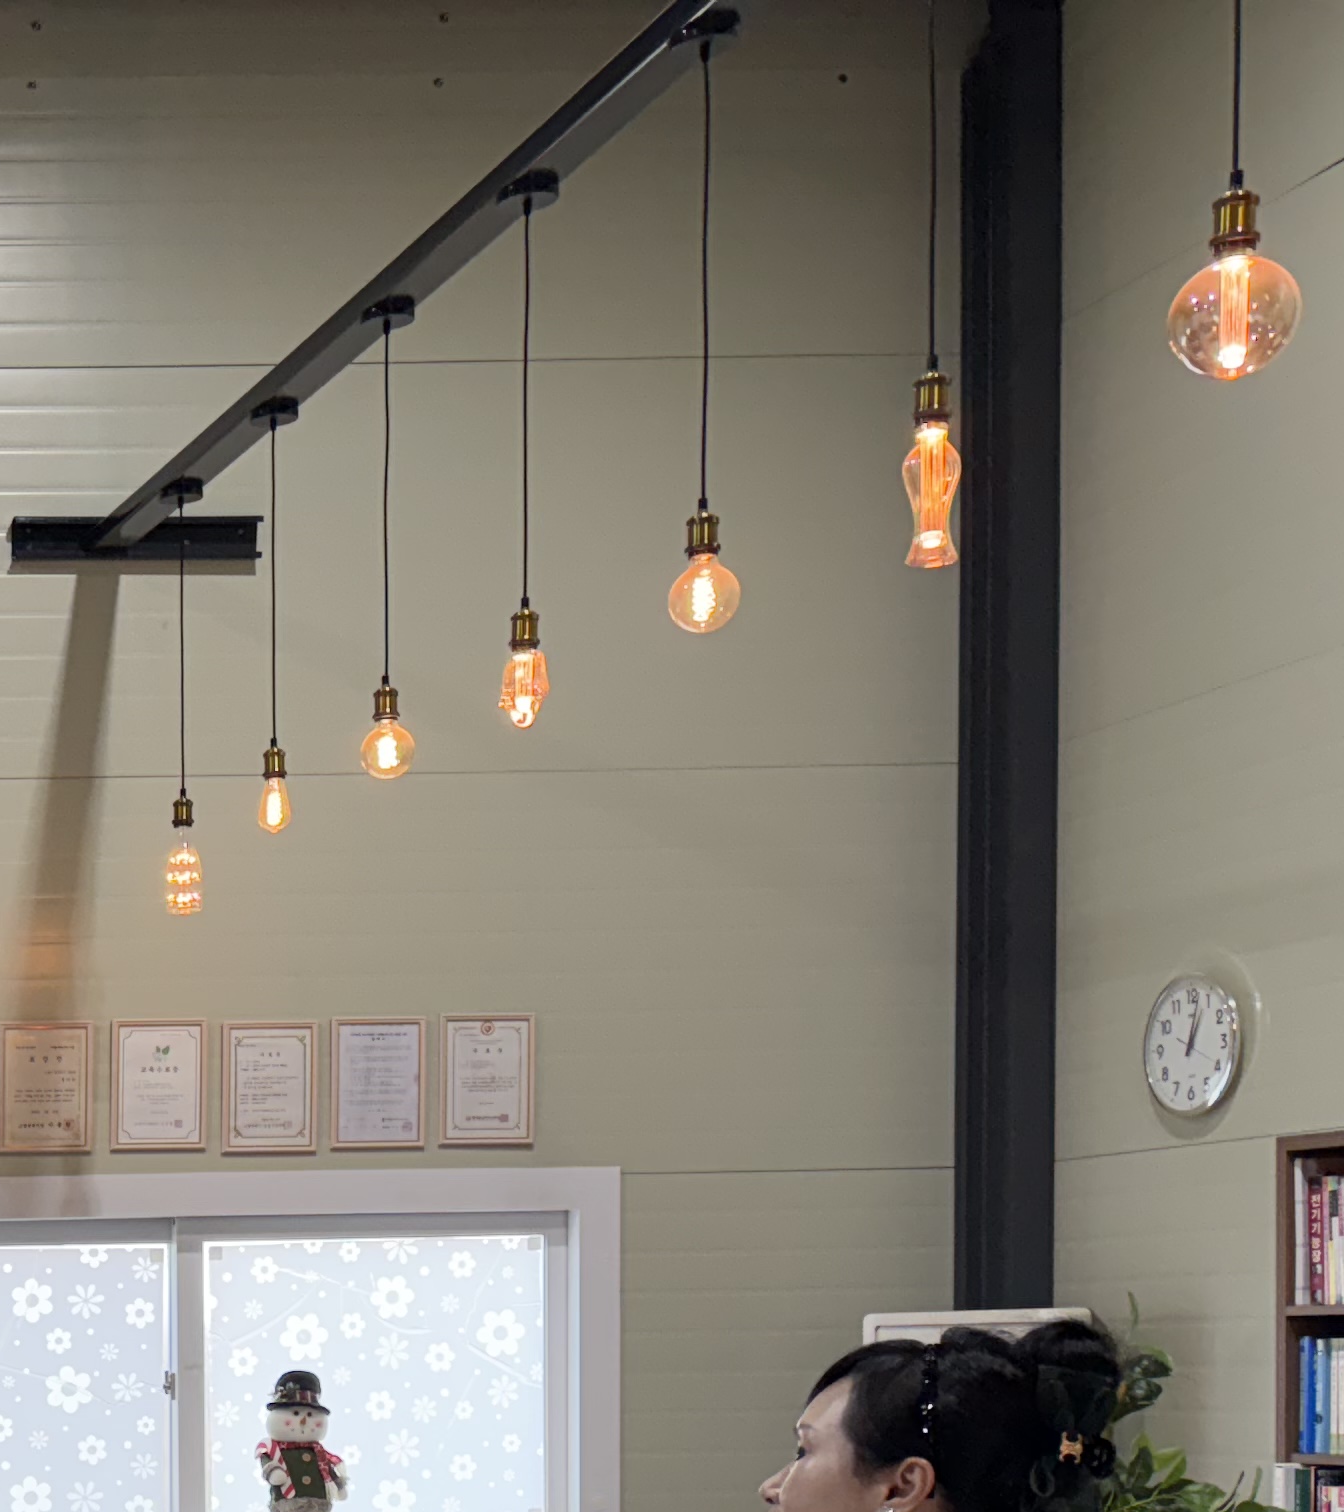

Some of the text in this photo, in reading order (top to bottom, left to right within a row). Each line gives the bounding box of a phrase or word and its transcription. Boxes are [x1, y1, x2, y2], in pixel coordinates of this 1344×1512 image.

[1186, 988, 1199, 1004] 12
[1172, 1000, 1180, 1015] 11
[1216, 1009, 1224, 1024] 2
[1161, 1020, 1172, 1036] 10
[1220, 1034, 1228, 1048] 3
[1157, 1044, 1164, 1060] 9
[1214, 1059, 1220, 1070] 4
[1162, 1067, 1168, 1081] 8
[1173, 1082, 1180, 1096] 7
[1188, 1086, 1194, 1100] 6
